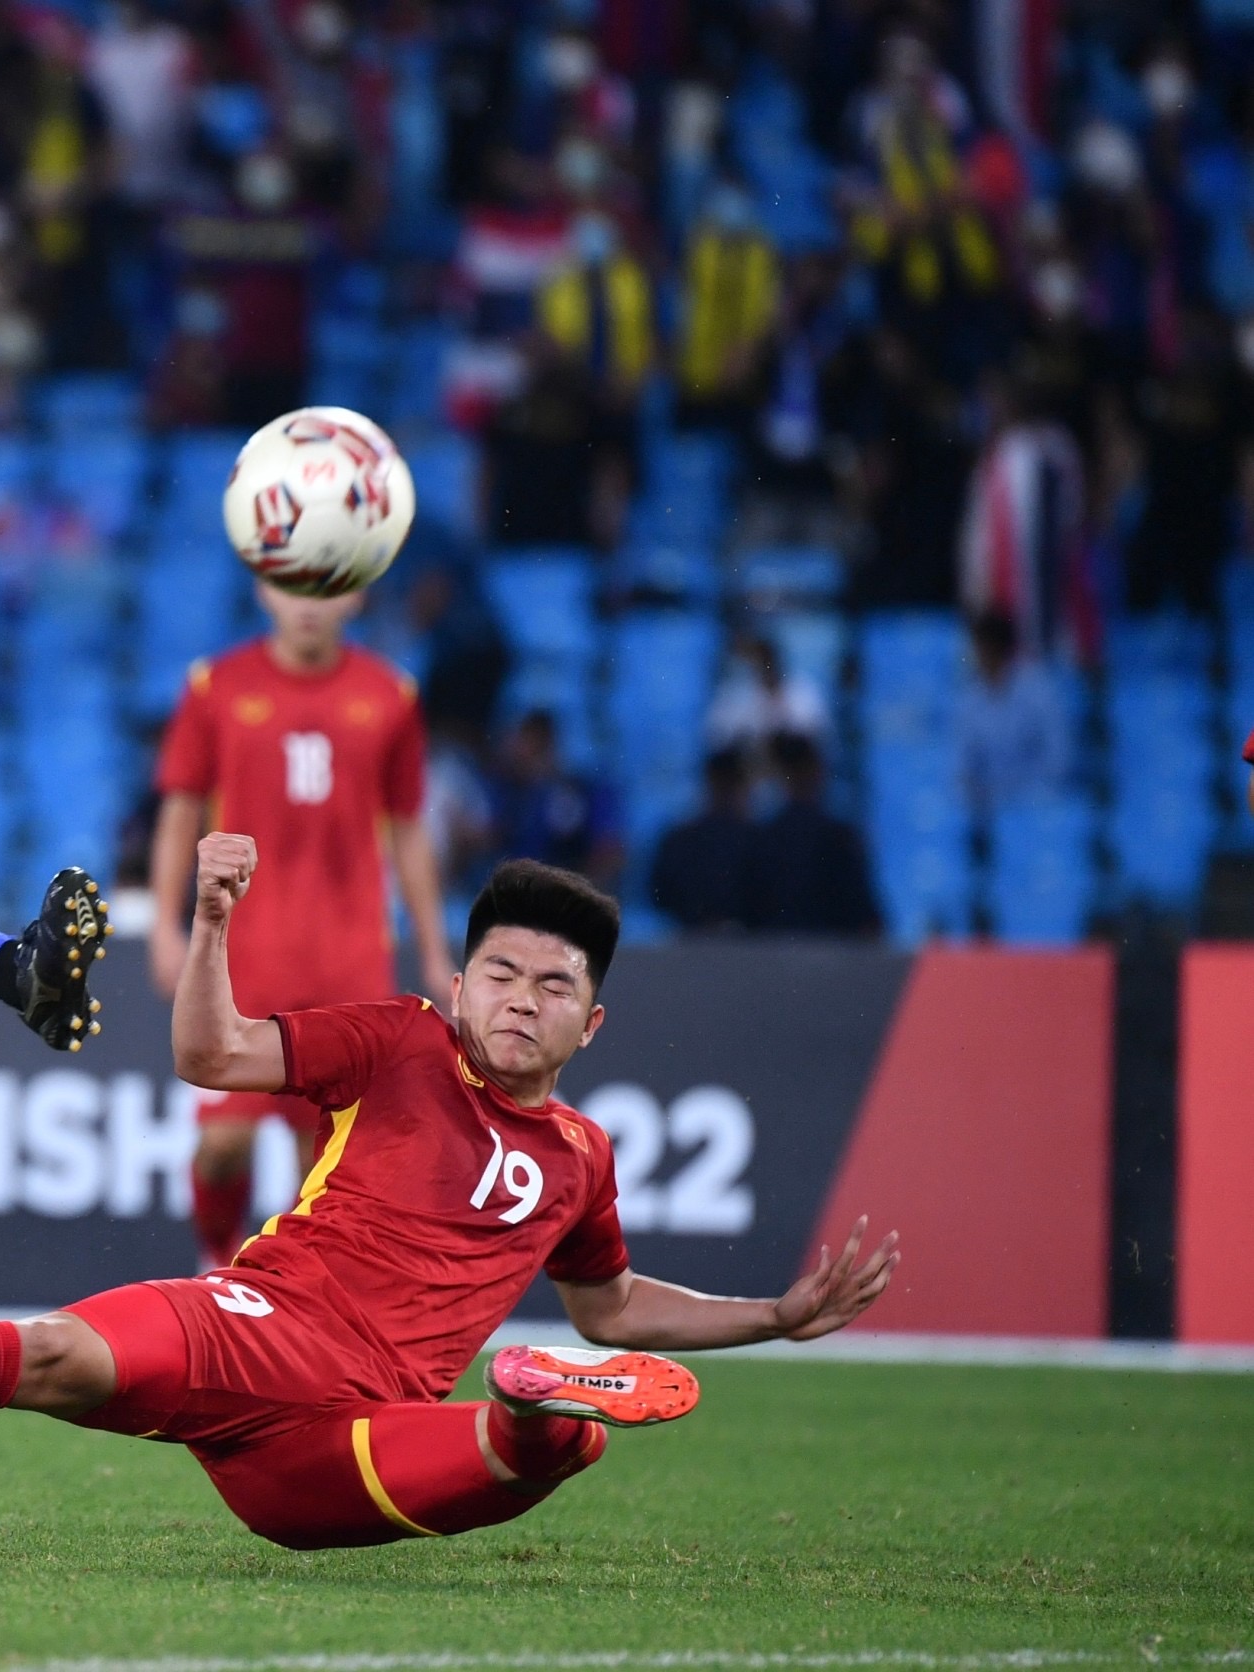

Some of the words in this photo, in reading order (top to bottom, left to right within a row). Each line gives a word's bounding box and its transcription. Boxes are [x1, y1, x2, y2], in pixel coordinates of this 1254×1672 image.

[282, 731, 334, 803] 18
[469, 1126, 544, 1225] 19
[578, 1082, 756, 1236] 22
[561, 1374, 626, 1391] TIEMPO
